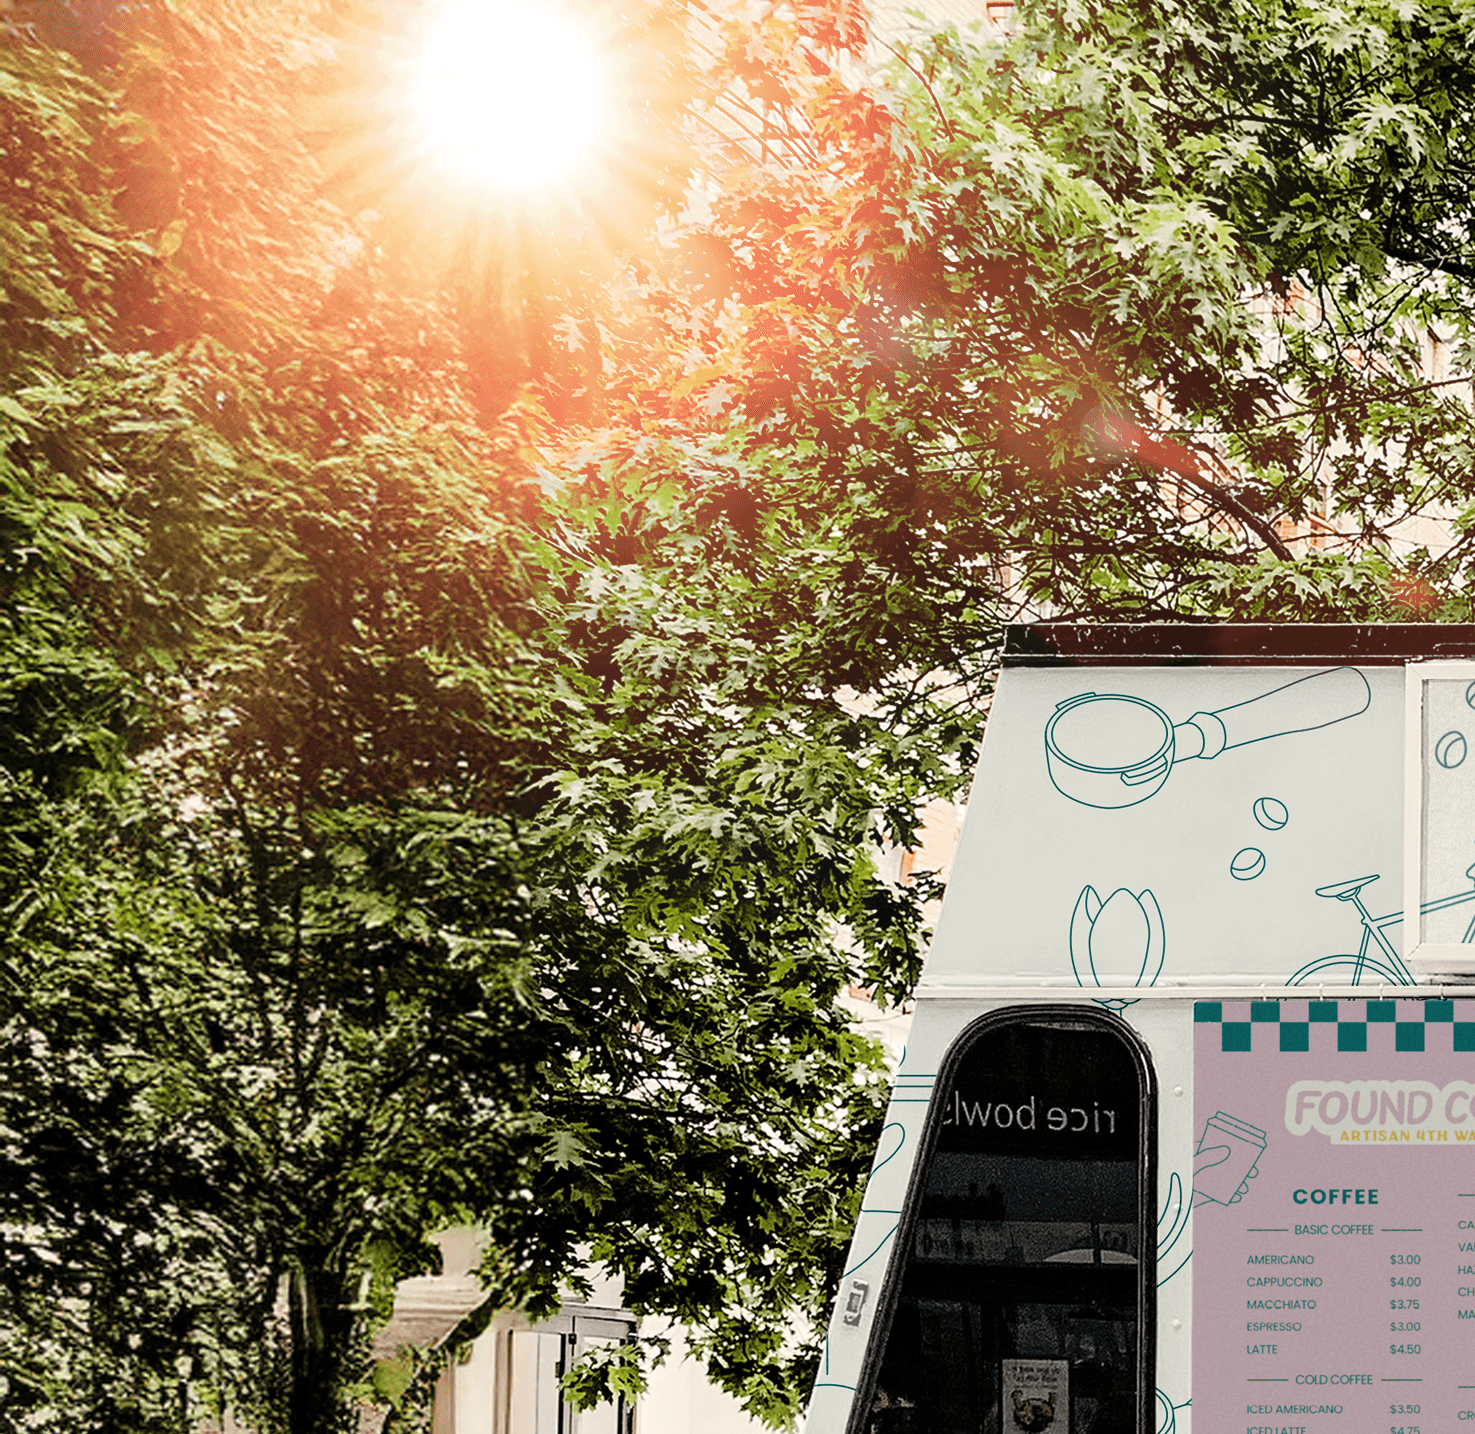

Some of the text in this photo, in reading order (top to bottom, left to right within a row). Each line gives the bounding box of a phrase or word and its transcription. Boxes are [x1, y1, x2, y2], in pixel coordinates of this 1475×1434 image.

[1295, 1090, 1433, 1125] FOUND
[1340, 1130, 1410, 1142] ARTISAN
[1416, 1130, 1448, 1142] 4TH
[1292, 1188, 1379, 1206] COFFEE
[1294, 1224, 1374, 1236] BASIC COFFEE
[1246, 1254, 1422, 1266] AMERICANO $3.00
[1246, 1276, 1422, 1288] CAPPUCCINO $4.00
[1246, 1299, 1420, 1311] MACCHIATO $3.75
[1246, 1321, 1422, 1332] ESPRESSO $3.00
[1246, 1343, 1422, 1355] LATTE $4.50
[1294, 1373, 1373, 1386] COLD COFFEE
[1246, 1404, 1421, 1415] ICED AMERICANO $3.50
